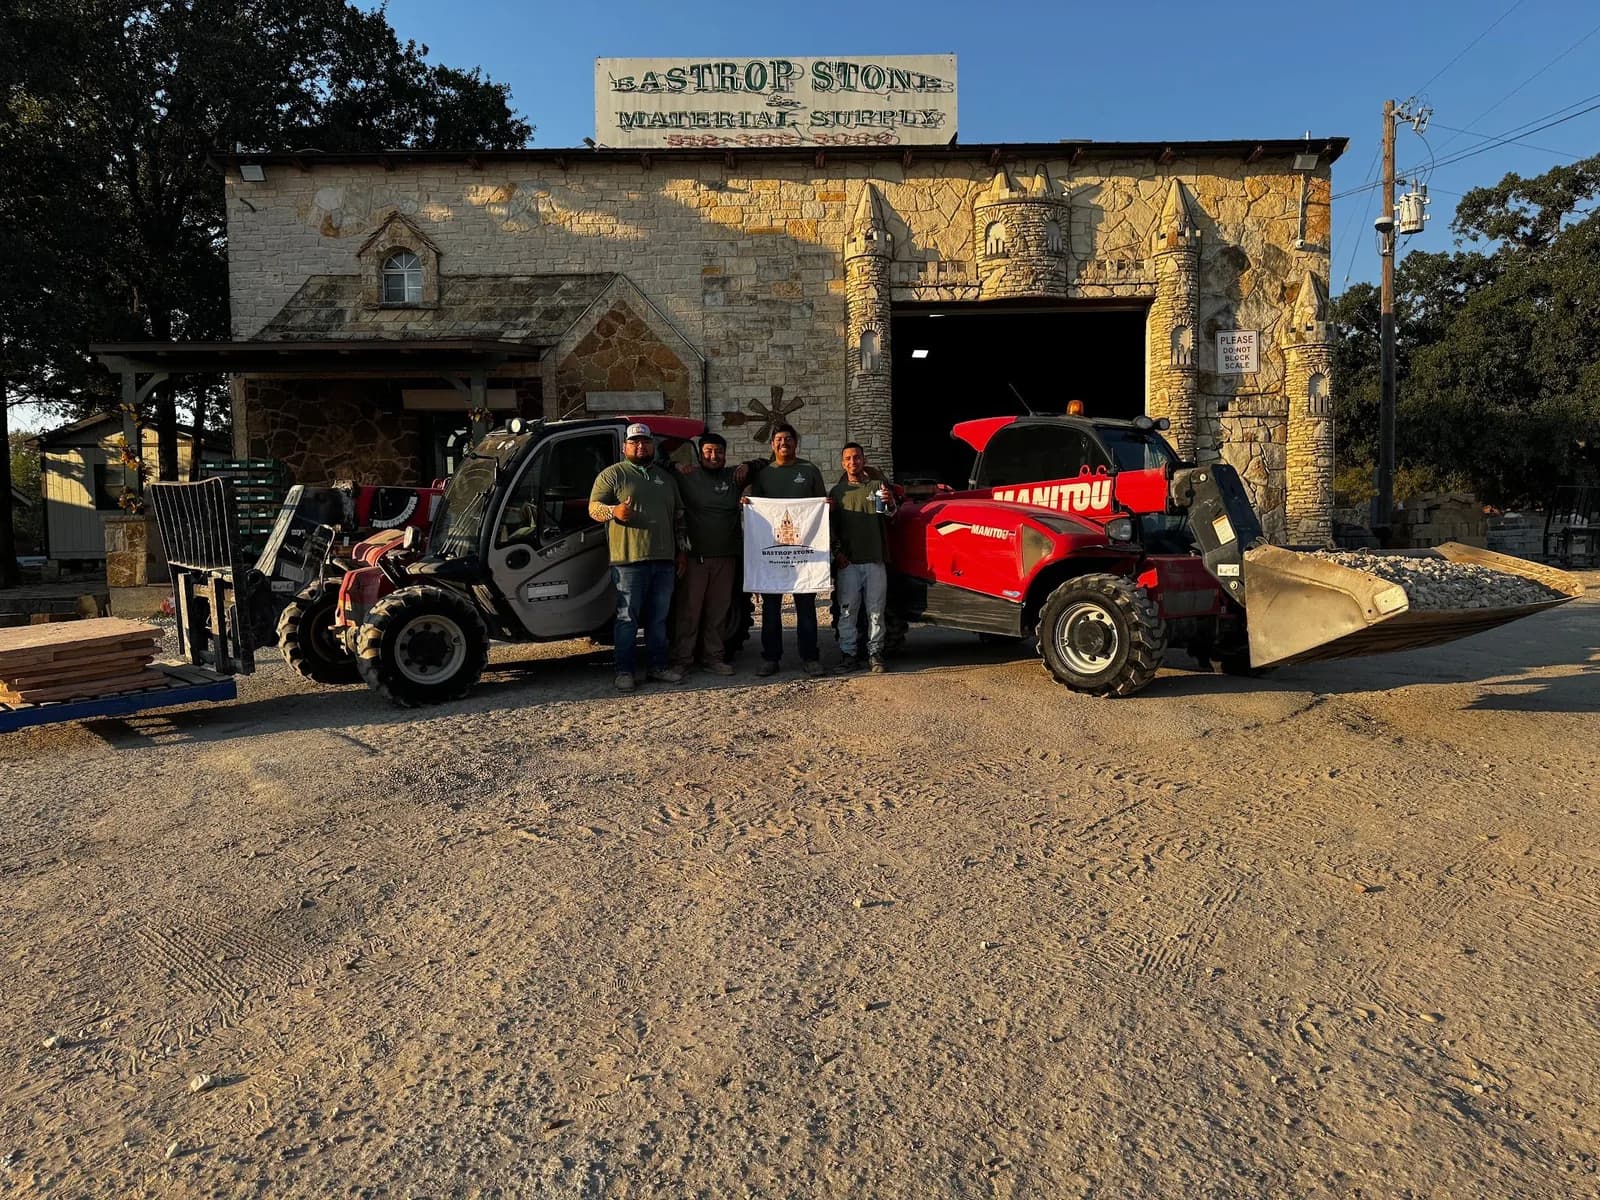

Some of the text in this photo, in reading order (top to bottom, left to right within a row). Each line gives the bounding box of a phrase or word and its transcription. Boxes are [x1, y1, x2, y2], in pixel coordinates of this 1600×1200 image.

[609, 60, 954, 94] BASTROP STONE
[615, 109, 946, 131] MATERIAL SUPPLY
[1220, 336, 1253, 344] PLEASE
